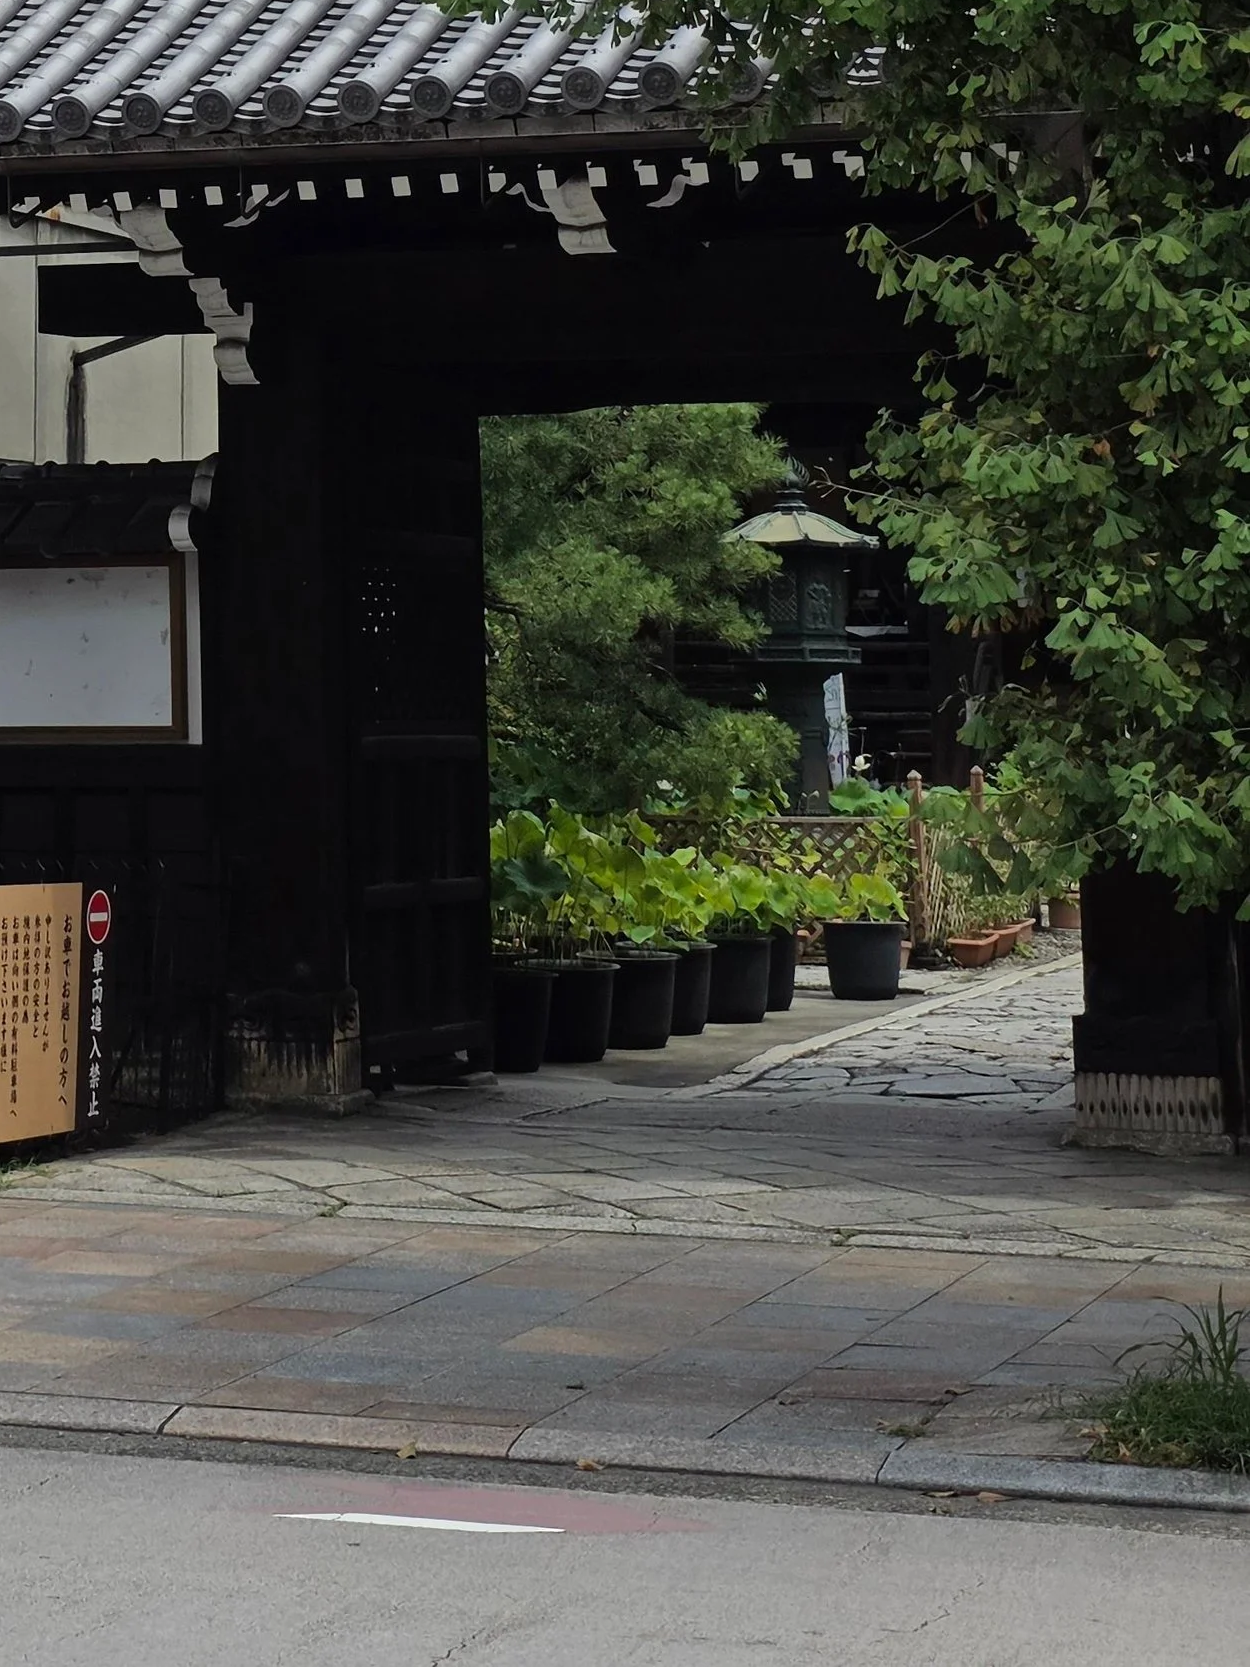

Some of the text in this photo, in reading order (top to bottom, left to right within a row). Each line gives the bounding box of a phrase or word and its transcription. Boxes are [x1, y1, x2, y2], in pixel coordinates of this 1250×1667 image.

[58, 914, 72, 1105] お車でお越しの方へ
[87, 948, 104, 1117] 車両進入禁止
